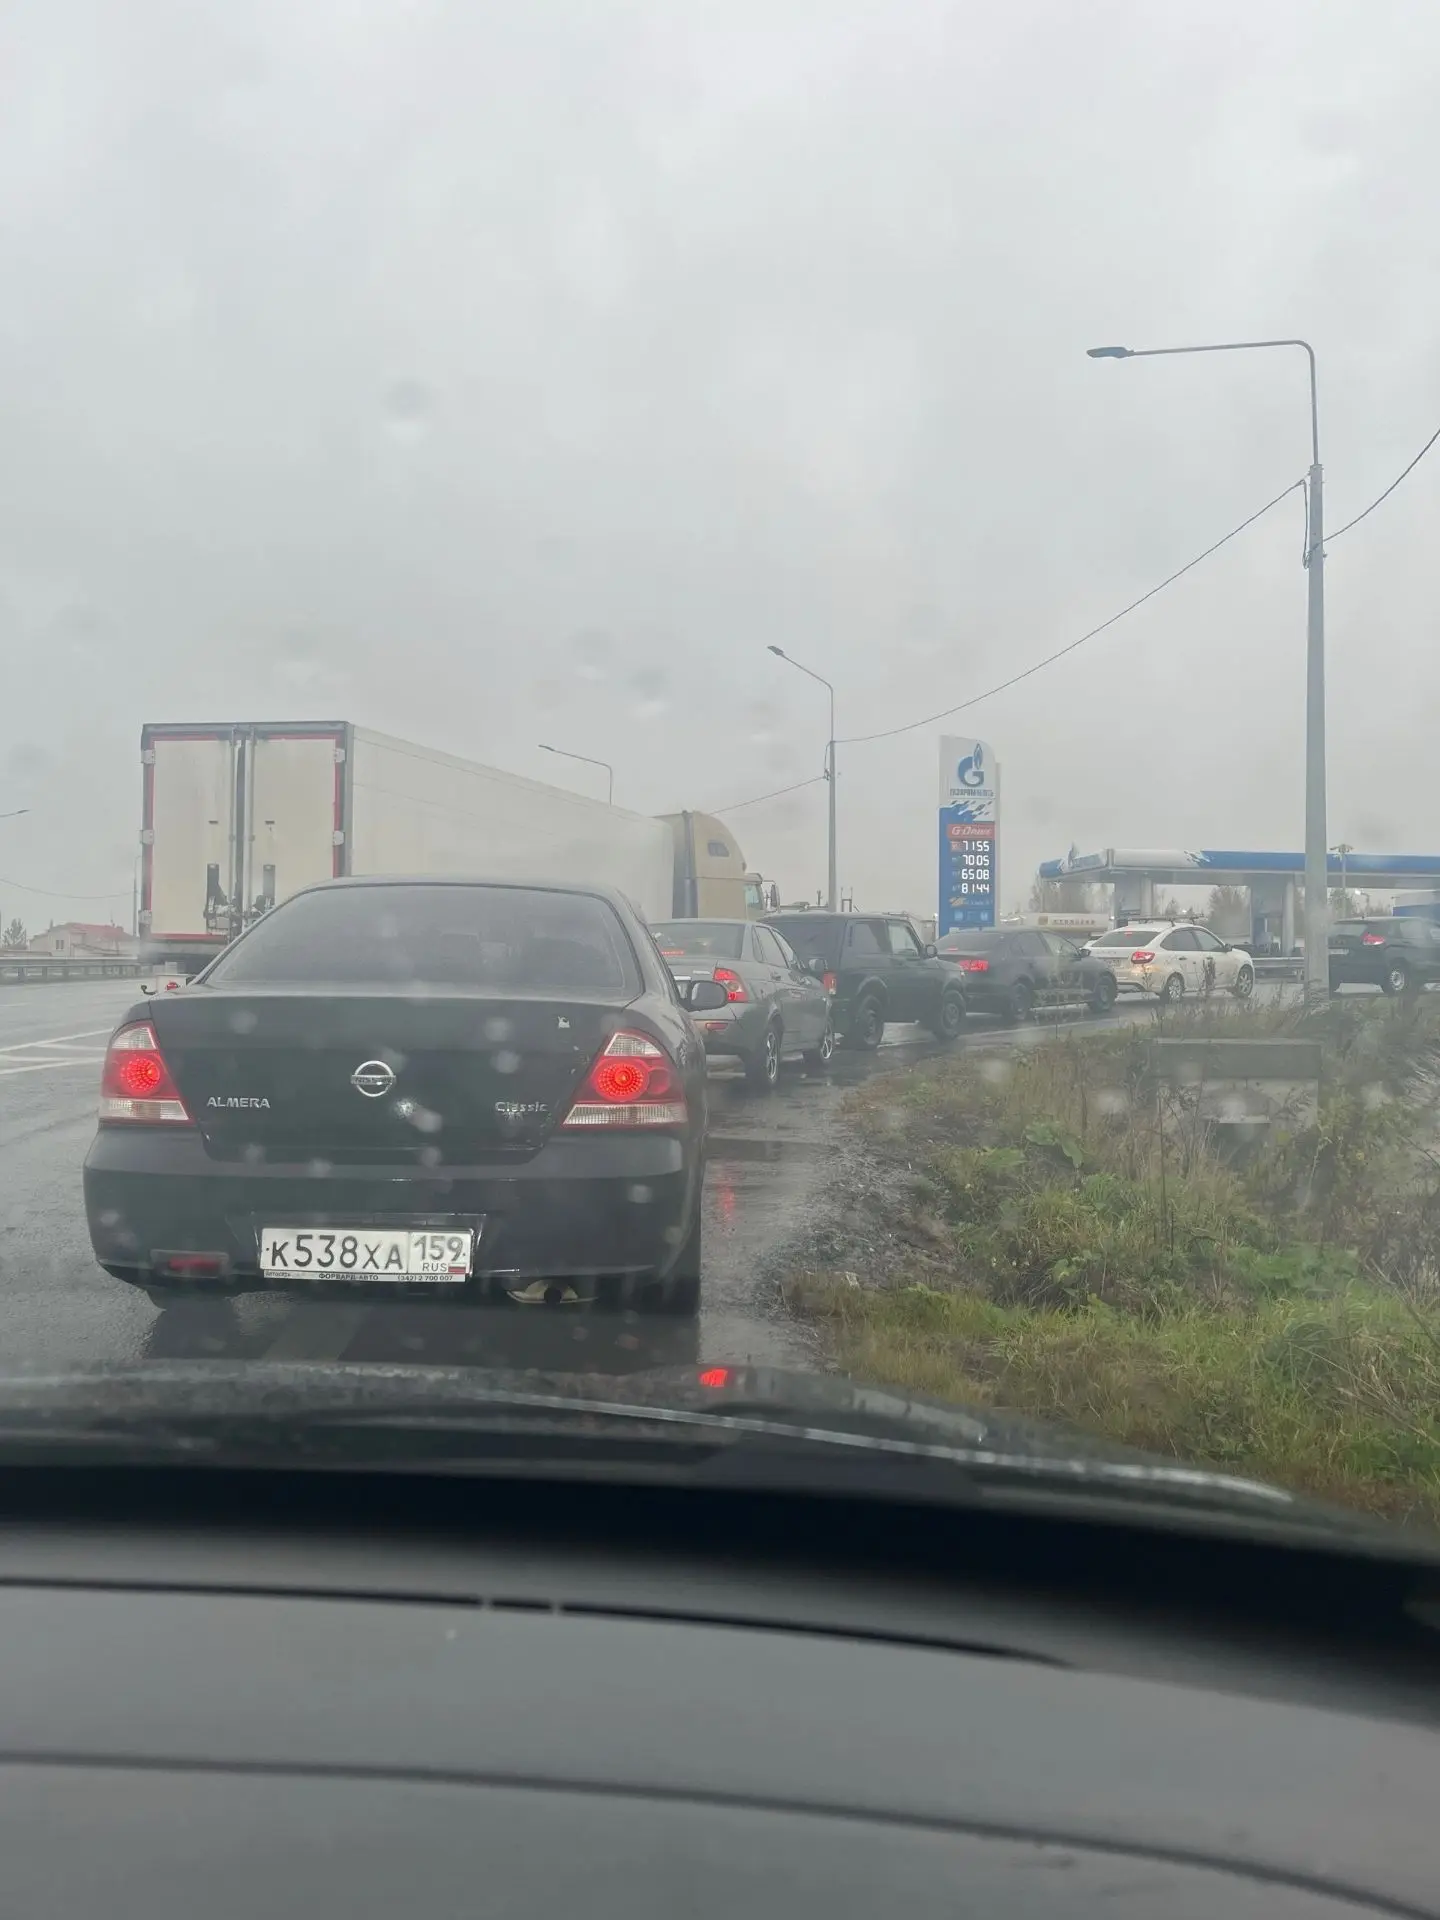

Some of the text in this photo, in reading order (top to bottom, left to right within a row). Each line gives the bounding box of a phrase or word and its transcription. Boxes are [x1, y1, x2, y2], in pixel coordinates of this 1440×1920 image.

[206, 1096, 271, 1109] ALMERA
[494, 1101, 549, 1112] Classic
[270, 1233, 464, 1270] К538ХА 159
[422, 1262, 448, 1273] RUS
